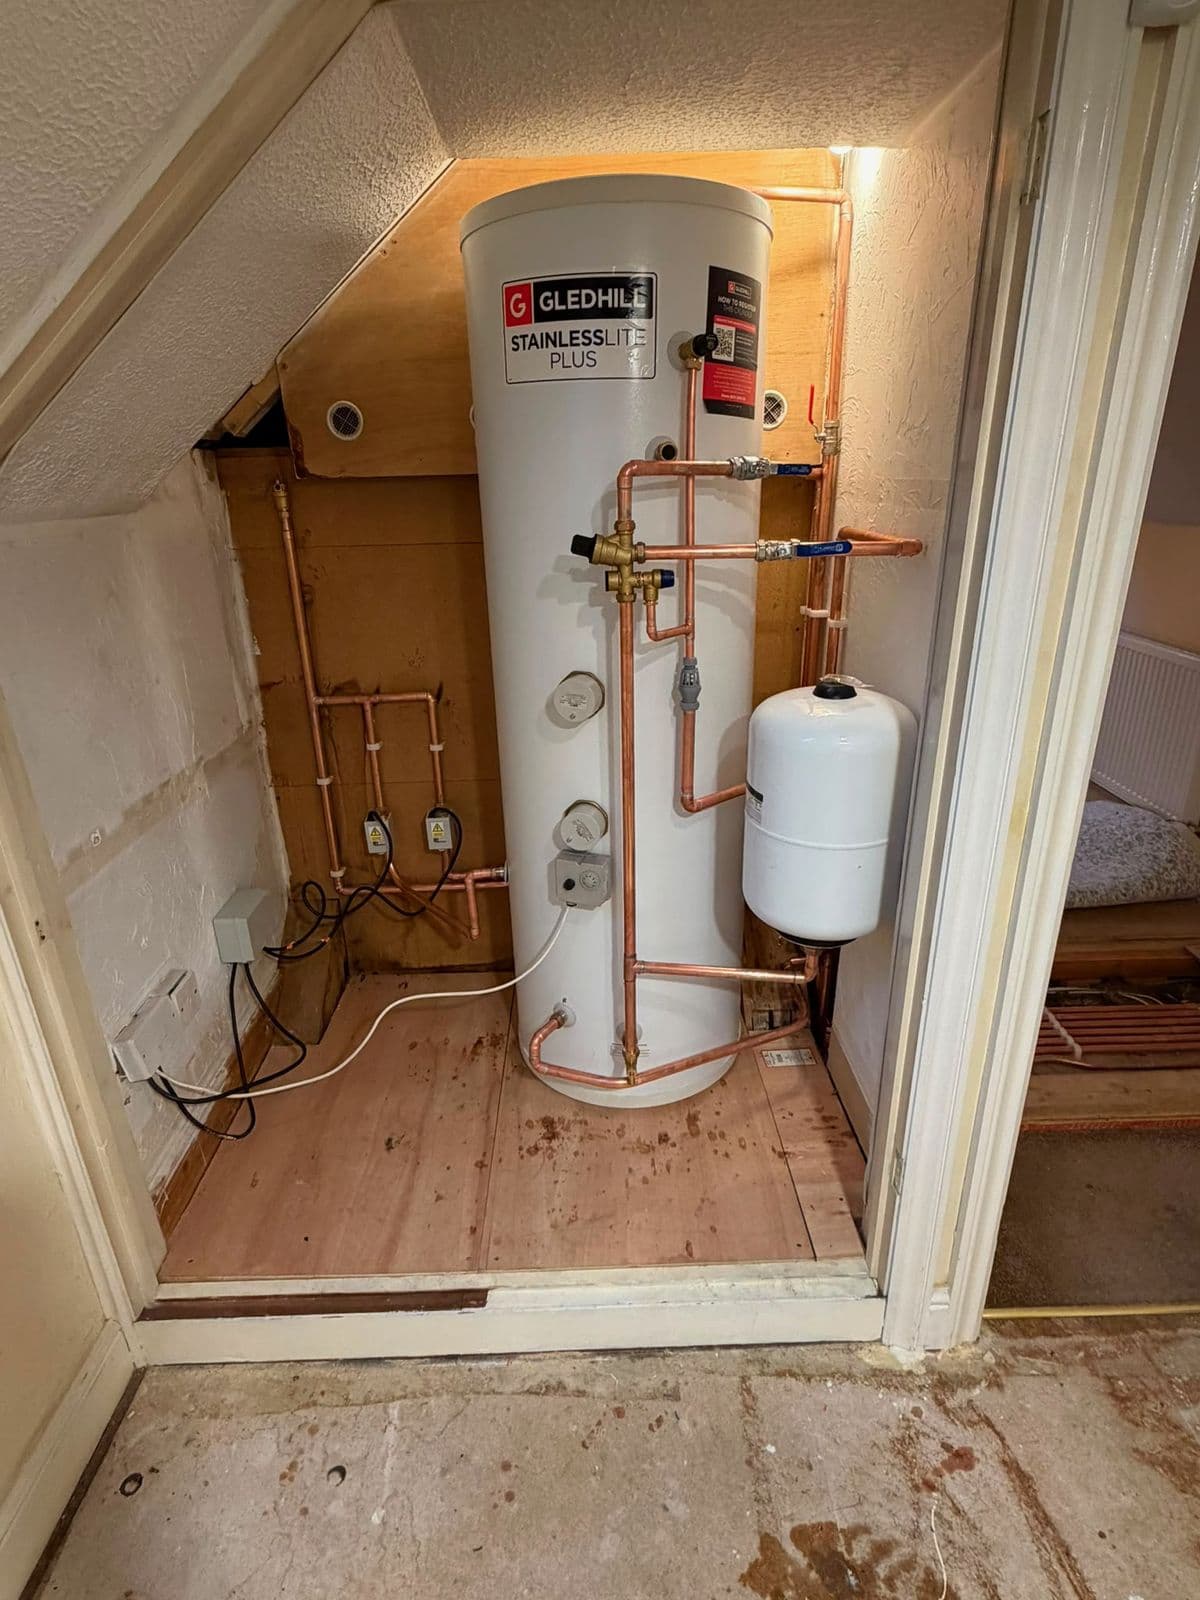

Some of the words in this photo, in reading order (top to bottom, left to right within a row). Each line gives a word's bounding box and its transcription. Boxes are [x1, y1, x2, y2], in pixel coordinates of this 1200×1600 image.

[539, 288, 647, 311] GLEDHILL
[511, 328, 647, 352] STAINLESSLITE
[551, 351, 597, 369] PLUS
